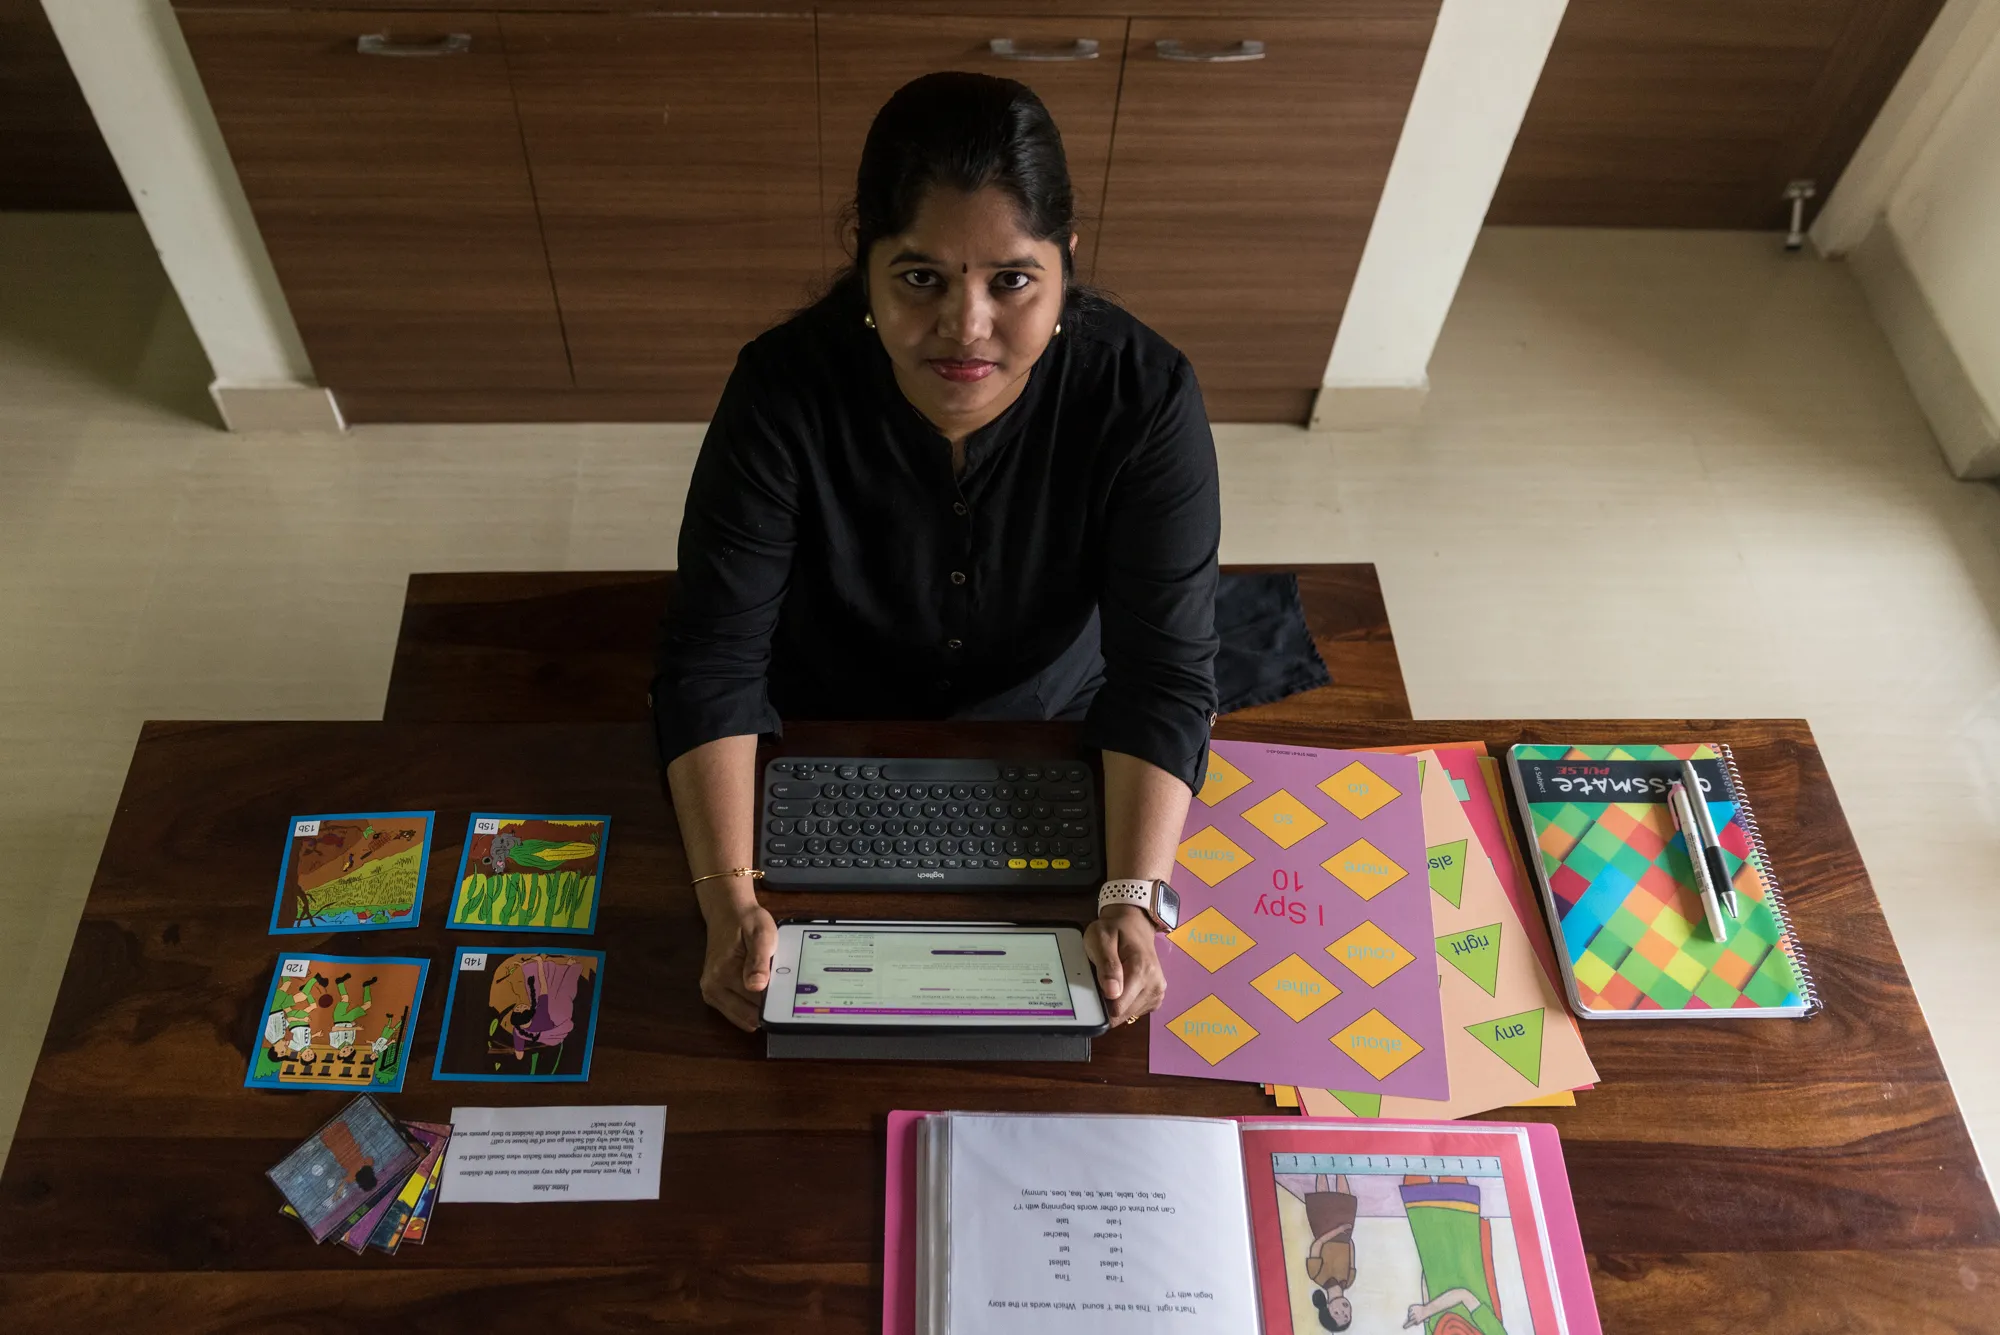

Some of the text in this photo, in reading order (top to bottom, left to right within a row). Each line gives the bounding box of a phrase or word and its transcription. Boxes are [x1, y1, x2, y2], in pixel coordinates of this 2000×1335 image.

[1556, 767, 1610, 775] PULSE
[1535, 772, 1546, 793] Subject
[1348, 783, 1369, 797] do
[1274, 813, 1293, 825] so
[298, 824, 315, 834] 13b
[477, 822, 494, 832] 15b
[1188, 848, 1234, 863] some
[1344, 861, 1388, 876] more
[1427, 855, 1453, 871] als
[917, 871, 944, 879] logitech
[1273, 869, 1304, 892] 10
[1253, 894, 1324, 926] I Spy
[1188, 928, 1236, 947] many
[1451, 934, 1489, 956] right
[1347, 945, 1395, 961] could
[286, 963, 303, 973] 12b
[464, 957, 482, 966] 14b
[1275, 980, 1320, 996] other
[1184, 1020, 1238, 1037] would
[1495, 1024, 1525, 1041] any
[1350, 1035, 1402, 1054] about
[1041, 1203, 1075, 1211] beginning
[1106, 1275, 1124, 1283] T-ina
[1194, 1291, 1213, 1300] begin
[988, 1300, 1006, 1308] story
[1136, 1304, 1151, 1312] This
[1175, 1306, 1196, 1314] That's
